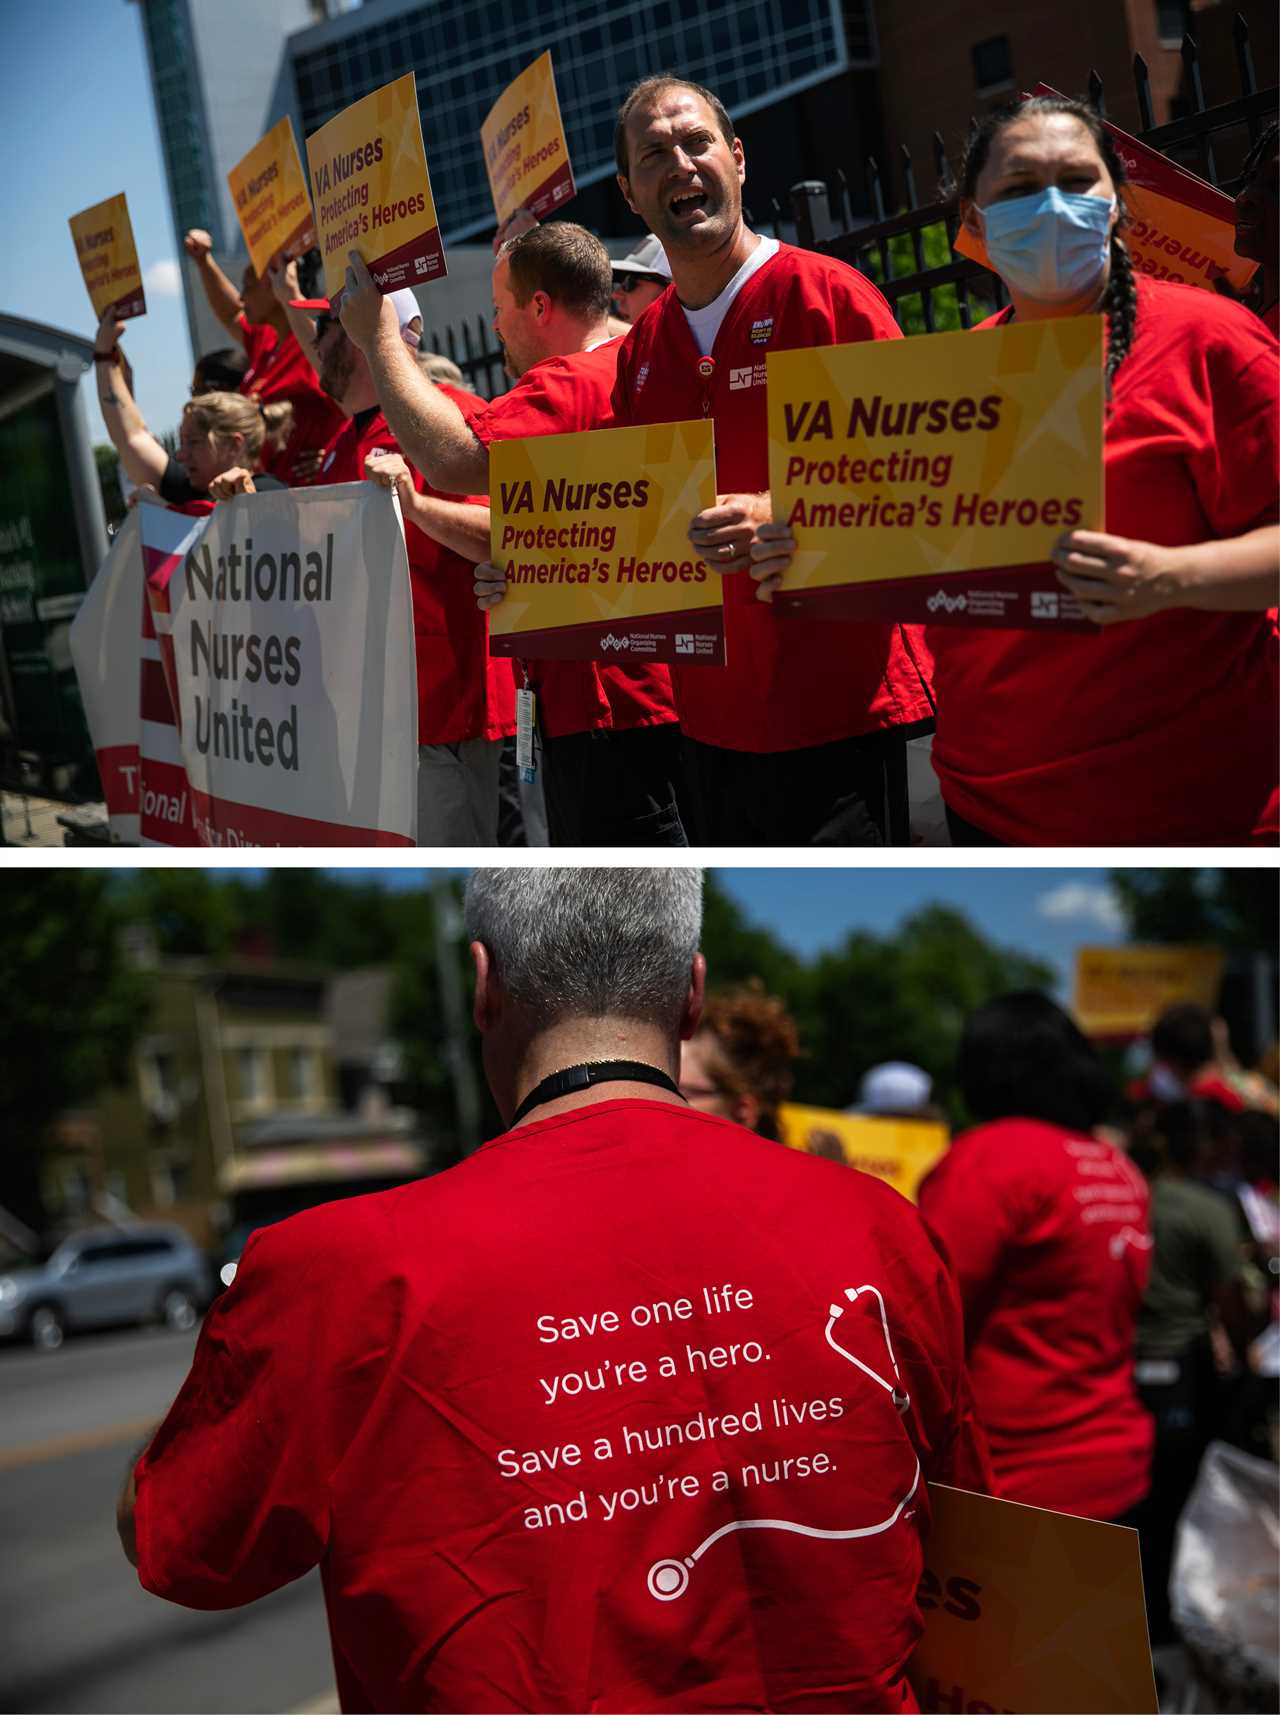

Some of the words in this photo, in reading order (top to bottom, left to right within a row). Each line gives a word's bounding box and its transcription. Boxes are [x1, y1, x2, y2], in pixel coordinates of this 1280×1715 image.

[315, 164, 331, 198] VA
[333, 137, 384, 186] Nurses
[523, 137, 560, 176] Heroes
[320, 182, 369, 227] Protecting
[326, 213, 370, 256] America's
[372, 192, 425, 230] Heroes
[783, 400, 834, 443] VA
[847, 395, 1003, 439] Nurses
[500, 480, 534, 515] VA
[543, 477, 649, 513] Nurses
[785, 449, 953, 488] Protecting
[501, 520, 617, 552] Protecting
[787, 495, 943, 529] America's
[952, 493, 1084, 528] Heroes
[185, 533, 334, 602] National
[504, 557, 610, 584] America's
[616, 556, 707, 584] Heroes
[190, 619, 302, 687] Nurses
[195, 695, 300, 772] United
[536, 1309, 620, 1343] Save
[631, 1297, 693, 1327] one
[702, 1283, 754, 1315] life
[539, 1359, 648, 1405] you're
[659, 1355, 677, 1378] a
[686, 1341, 771, 1373] hero.
[497, 1443, 582, 1478] Save
[593, 1437, 614, 1460] a
[622, 1402, 763, 1455] hundred
[772, 1396, 845, 1428] lives
[523, 1491, 588, 1529] and
[598, 1474, 701, 1521] you're
[711, 1469, 730, 1493] a
[741, 1451, 838, 1488] nurse.
